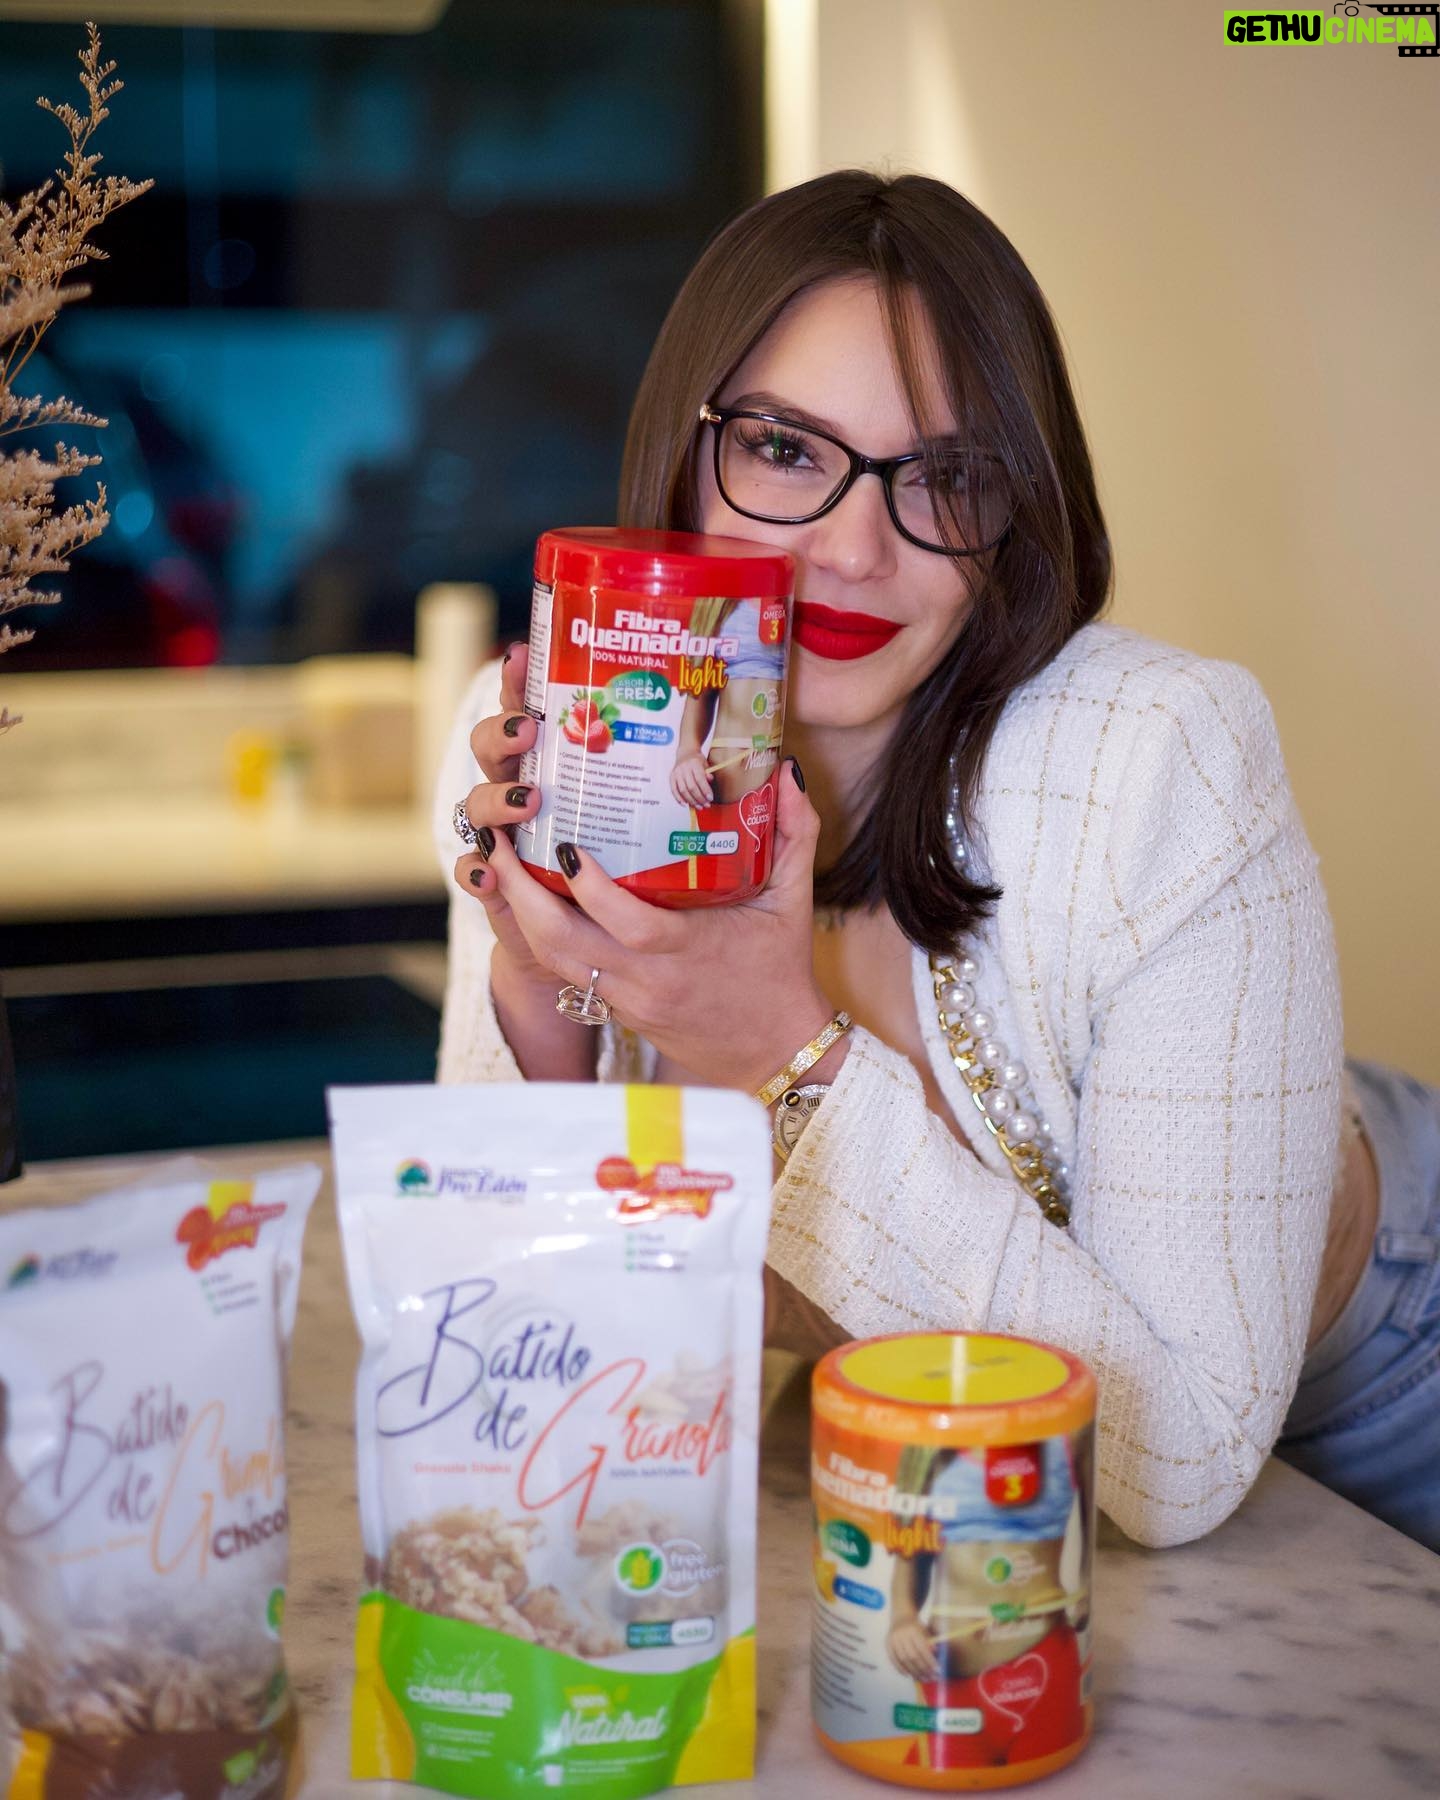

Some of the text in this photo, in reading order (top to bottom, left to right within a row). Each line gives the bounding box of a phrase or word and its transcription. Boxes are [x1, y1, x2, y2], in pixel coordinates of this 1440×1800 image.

[614, 609, 681, 634] Fibra
[770, 620, 779, 640] 3
[571, 618, 740, 657] Quemadora
[618, 653, 669, 669] NATURAL
[679, 657, 729, 691] light
[615, 686, 667, 700] FRESA
[673, 841, 704, 851] 15 OZ
[710, 840, 735, 848] 440G
[376, 1278, 592, 1438] Batido
[474, 1388, 528, 1451] de
[107, 1461, 157, 1524] de
[1004, 1475, 1023, 1500] 3
[407, 1685, 513, 1711] CONSUMIR
[557, 1705, 668, 1749] Natural
